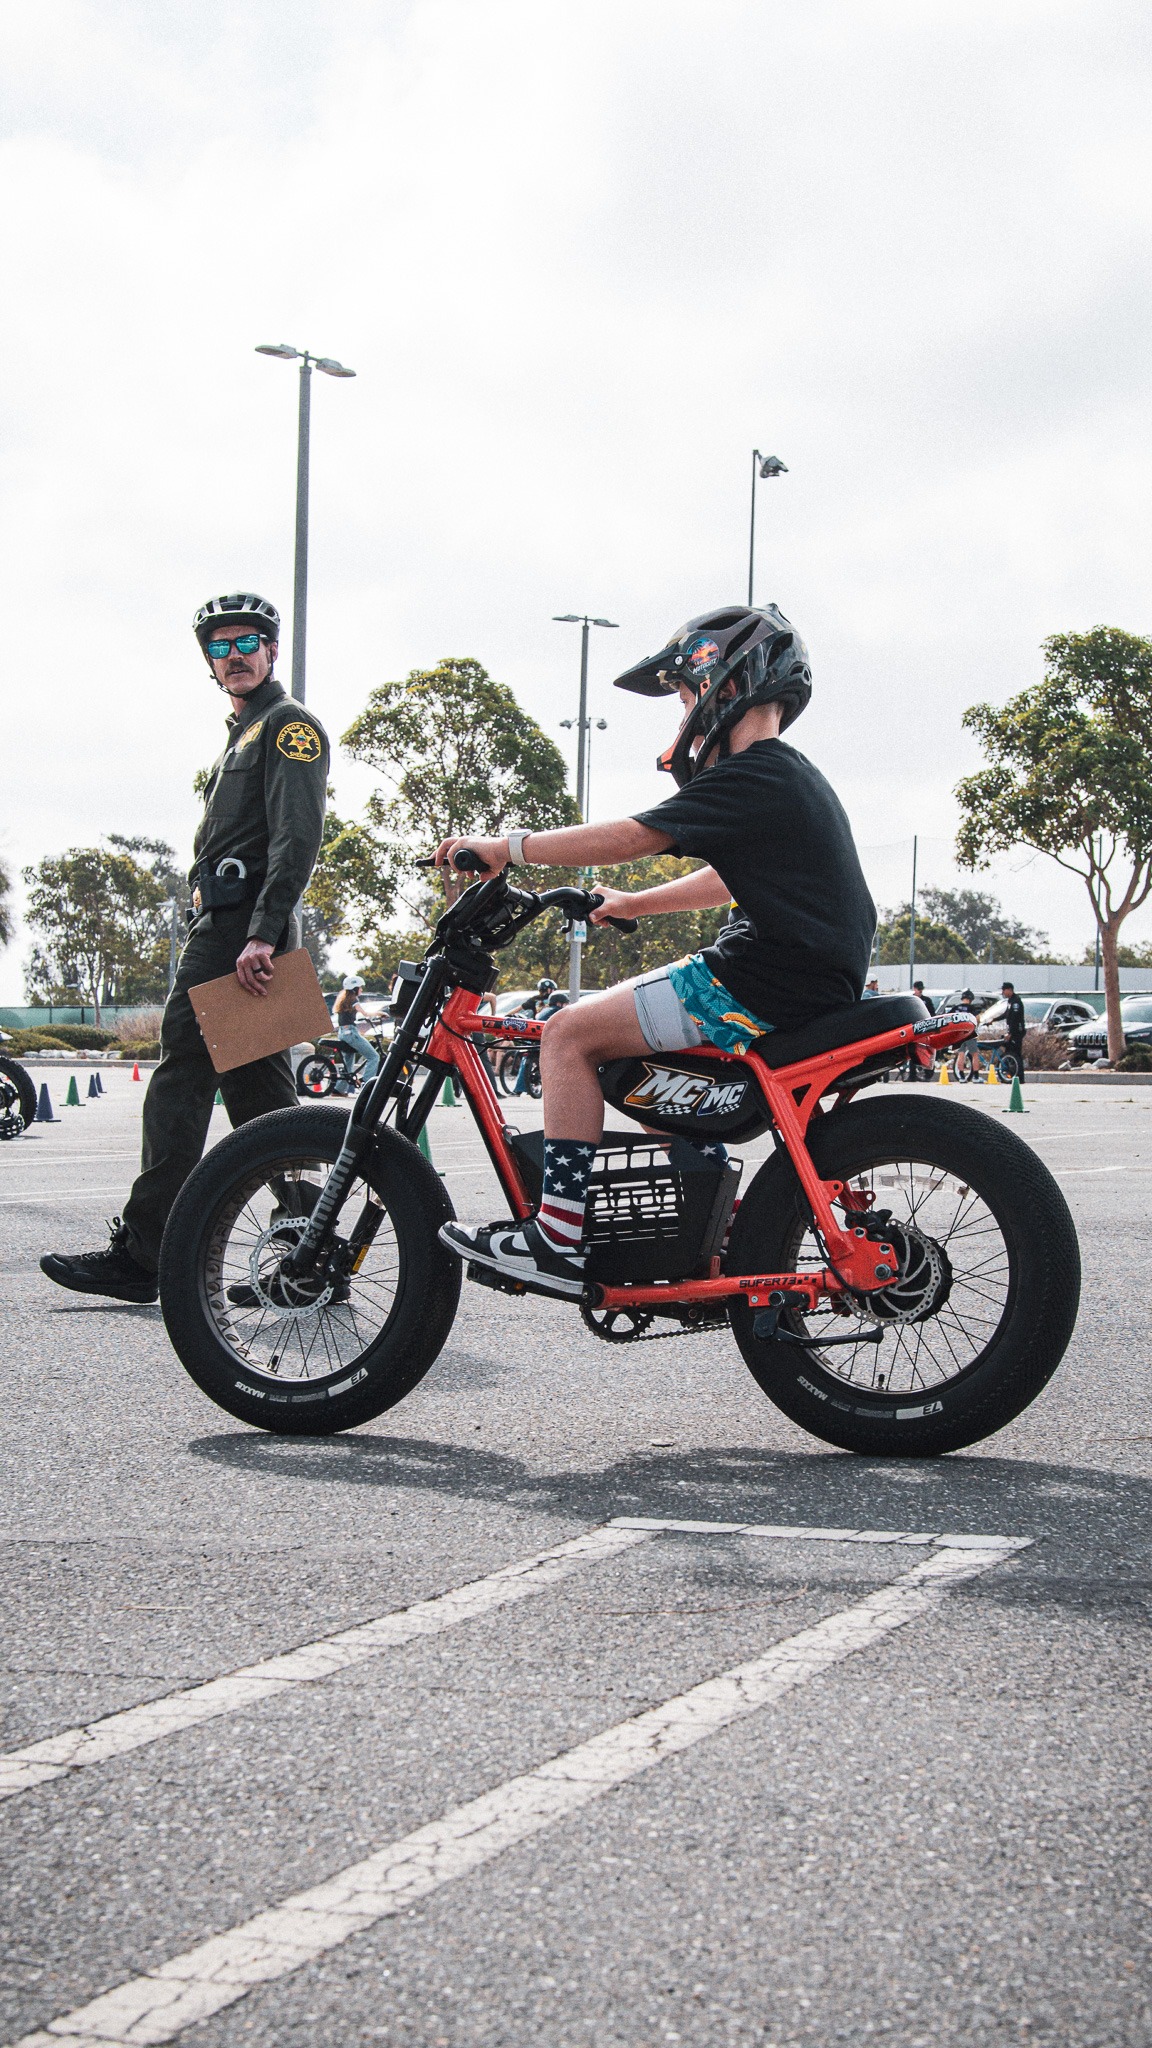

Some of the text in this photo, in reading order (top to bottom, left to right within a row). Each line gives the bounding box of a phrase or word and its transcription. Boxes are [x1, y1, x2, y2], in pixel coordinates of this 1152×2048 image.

[280, 724, 301, 743] ORANGE
[634, 1068, 745, 1110] MC MC
[739, 1276, 797, 1289] SUPER73
[350, 1370, 367, 1386] 73
[234, 1381, 266, 1399] MAXXIS
[797, 1375, 829, 1401] MAXXIS
[922, 1401, 942, 1415] 73
